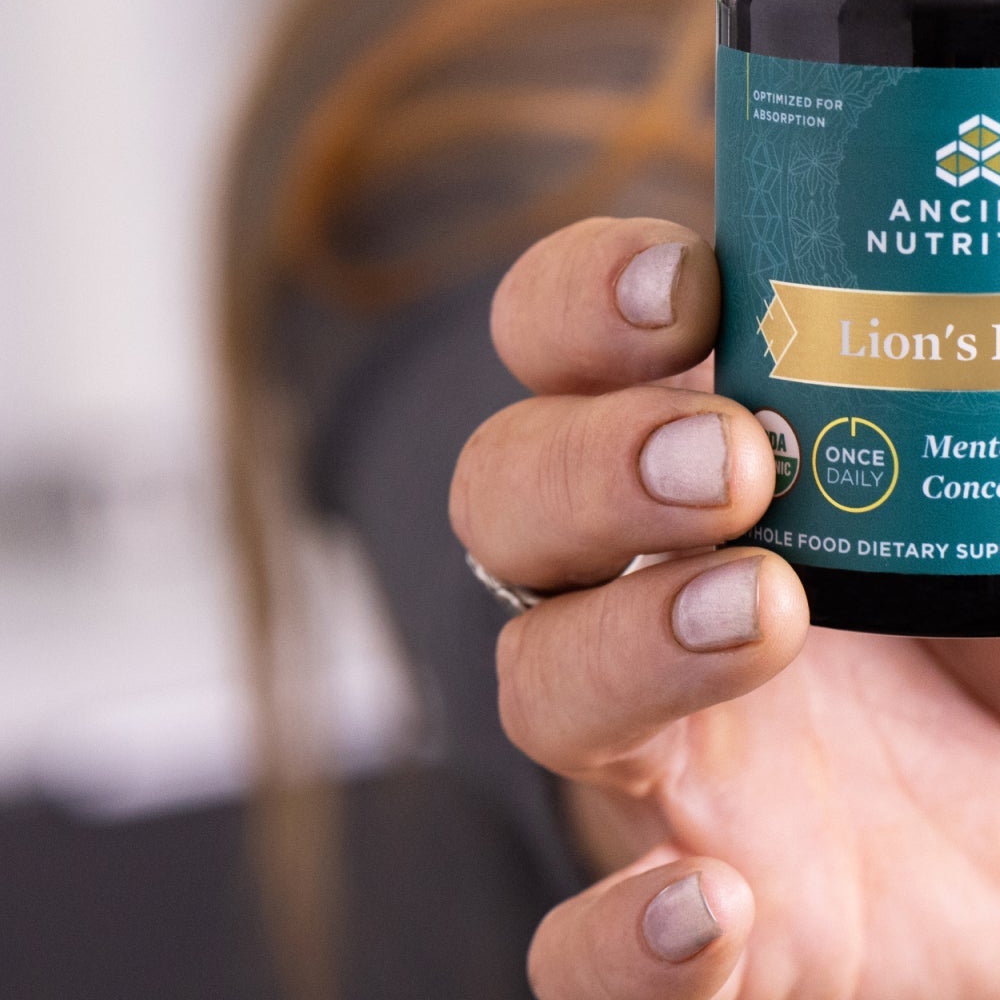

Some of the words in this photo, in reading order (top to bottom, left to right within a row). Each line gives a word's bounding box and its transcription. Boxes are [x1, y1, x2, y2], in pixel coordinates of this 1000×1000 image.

[753, 89, 812, 108] OPTIMIZED
[816, 98, 844, 111] FOR
[753, 108, 826, 128] ABSORPTION
[839, 317, 978, 362] Lion's
[825, 446, 885, 467] ONCE
[826, 467, 884, 487] DAILY
[798, 533, 850, 554] FOOD
[858, 540, 949, 559] DIETARY
